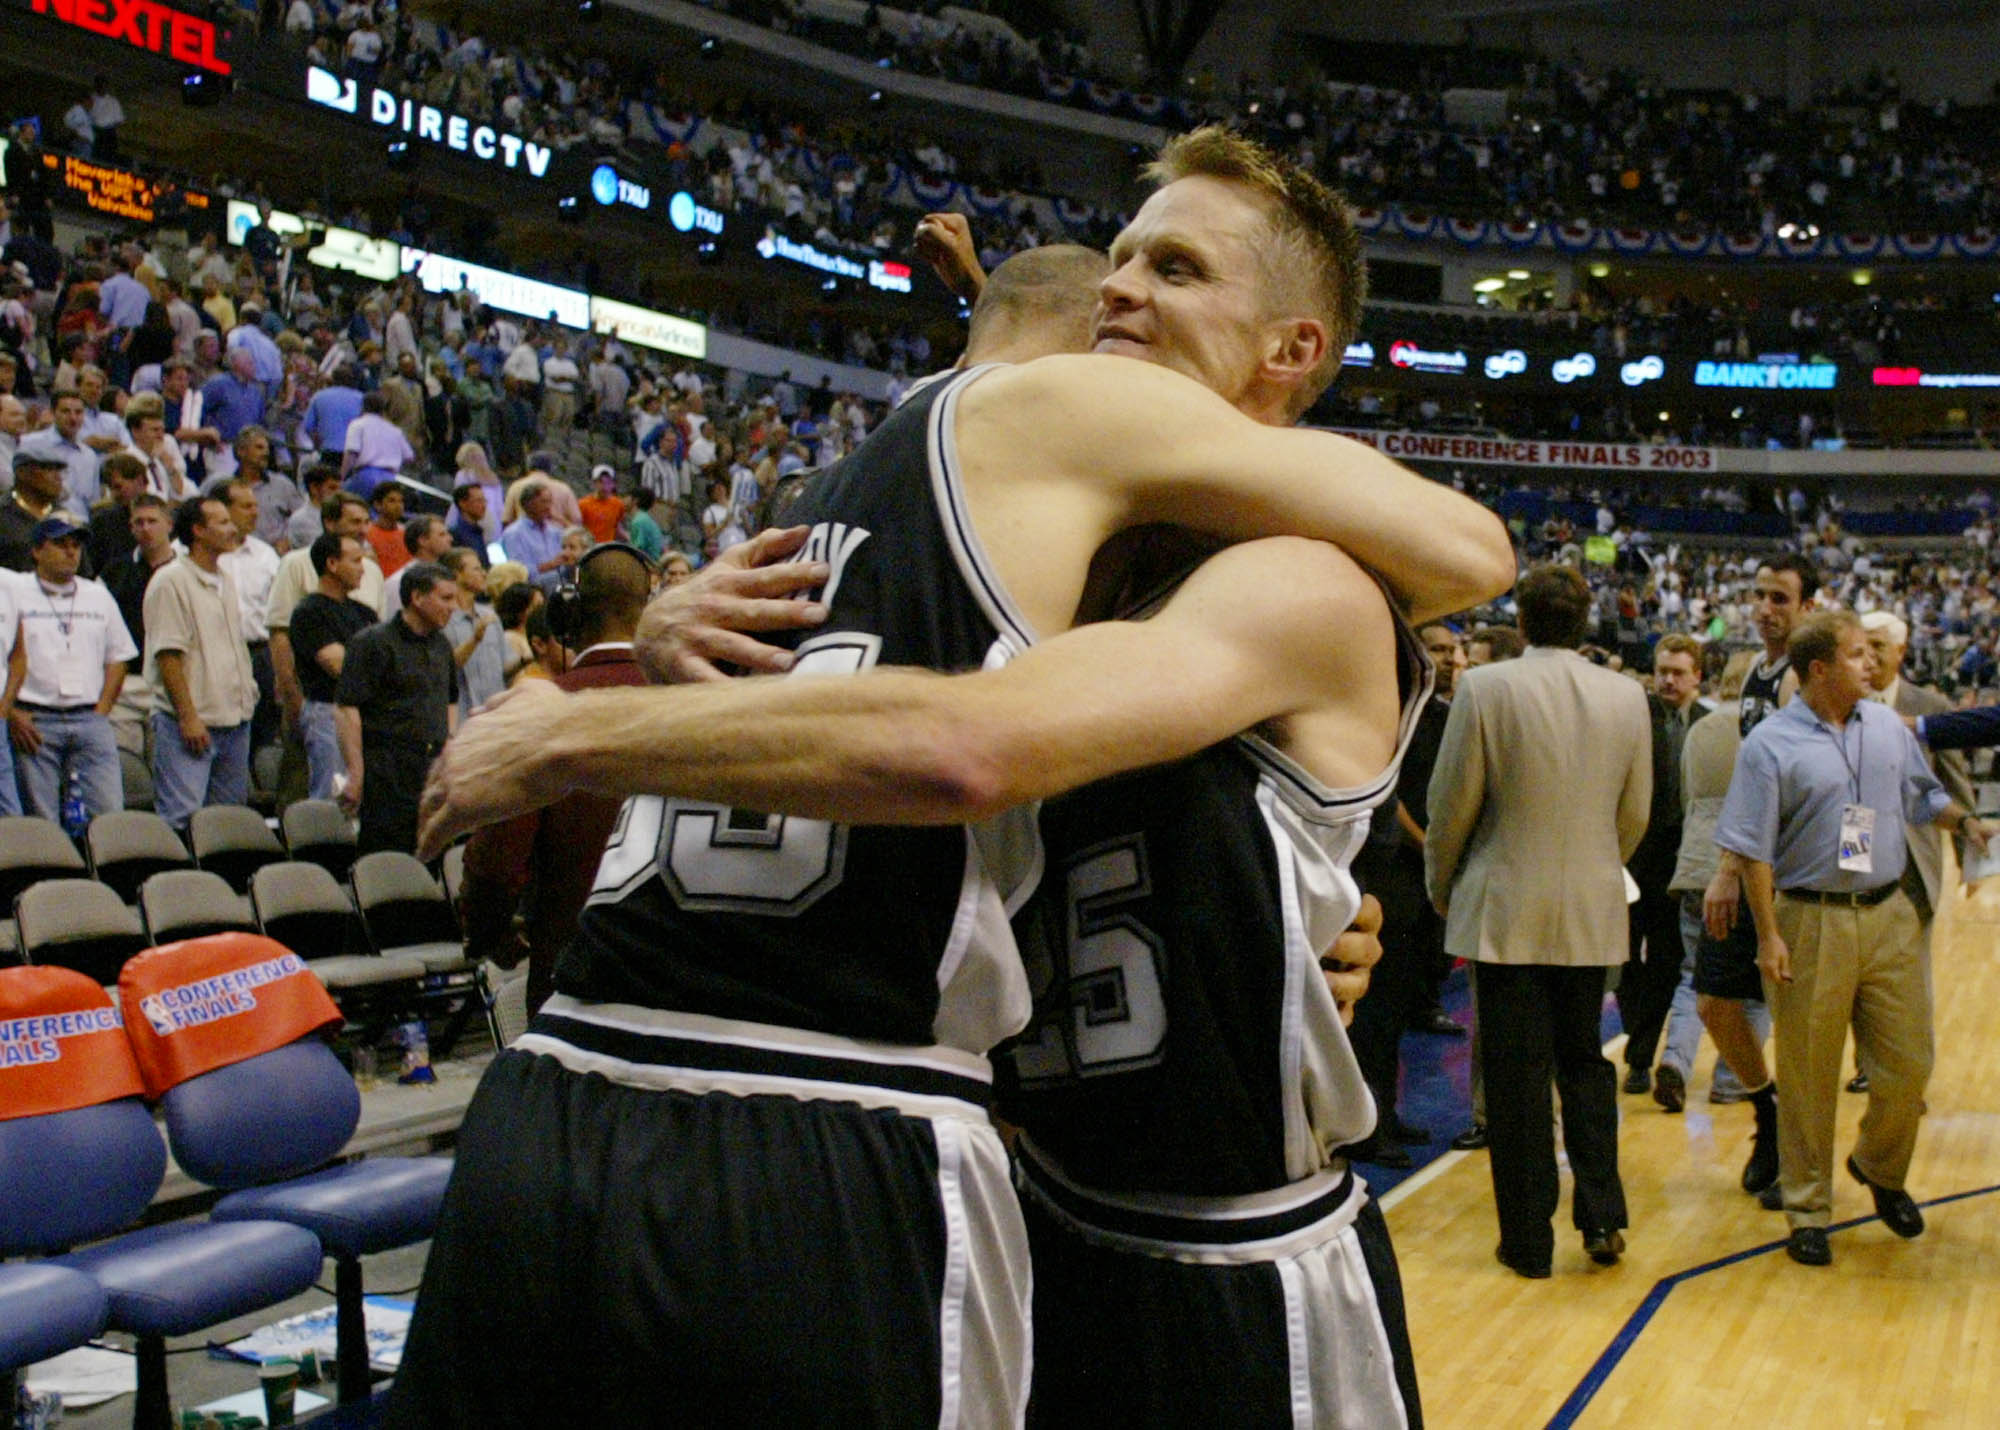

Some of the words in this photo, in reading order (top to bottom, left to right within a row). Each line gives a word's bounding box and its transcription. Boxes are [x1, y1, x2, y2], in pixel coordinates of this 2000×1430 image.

[371, 87, 551, 178] DIRECTV
[618, 178, 650, 209] TXU
[695, 204, 724, 235] TXU
[1384, 434, 1540, 464] CONFERENCE
[1547, 444, 1642, 466] FINALS
[1650, 448, 1712, 469] 2003
[171, 990, 255, 1027] FINALS
